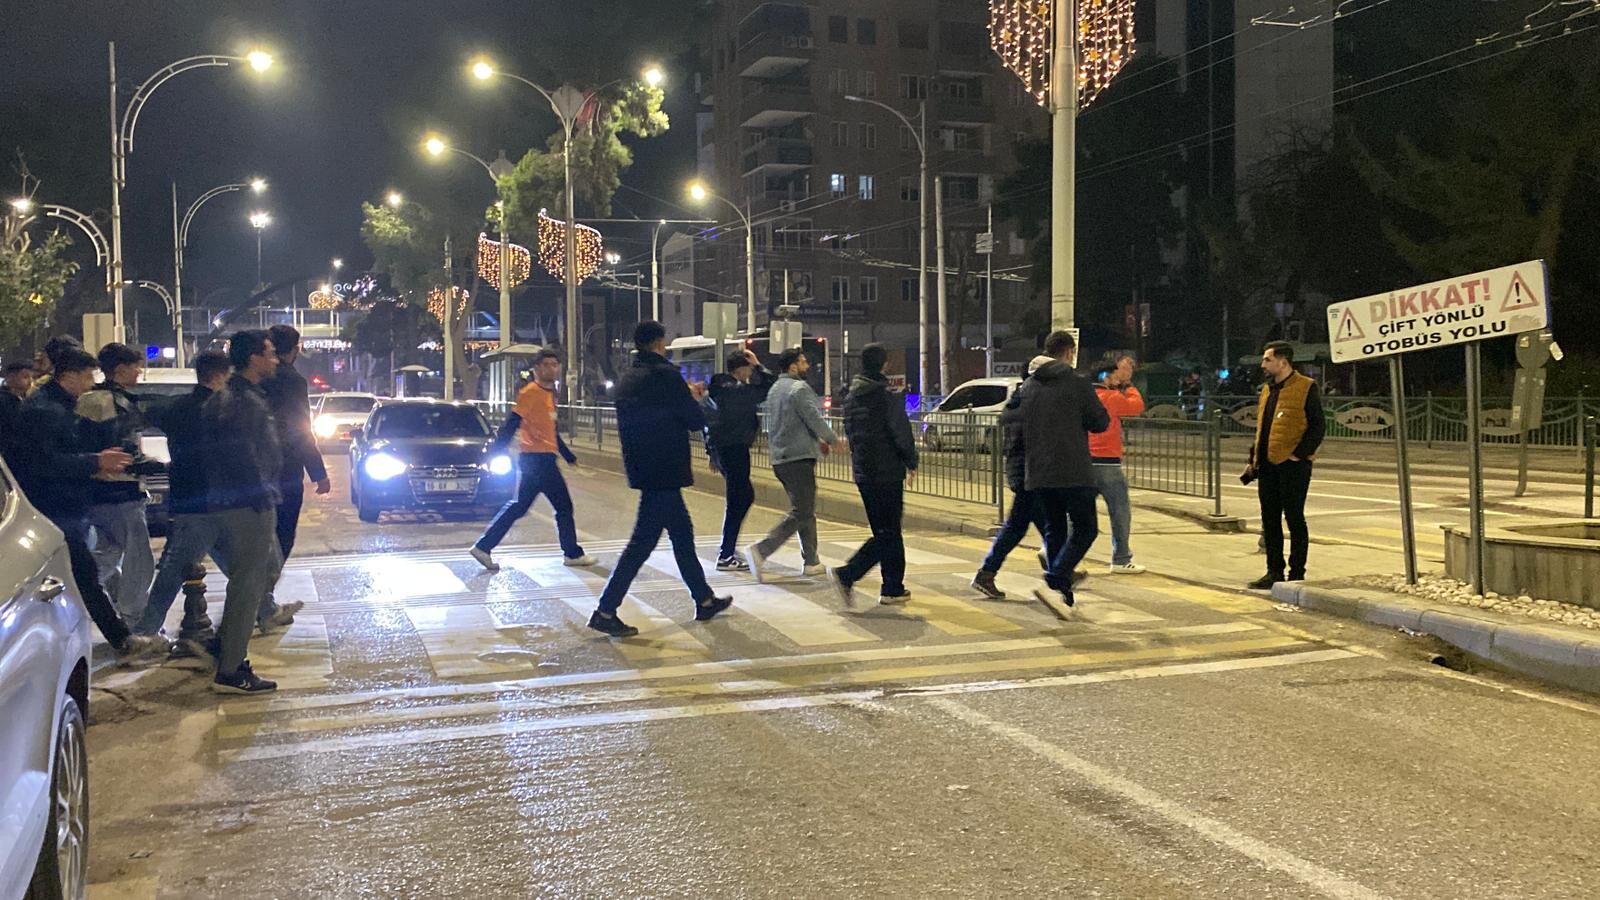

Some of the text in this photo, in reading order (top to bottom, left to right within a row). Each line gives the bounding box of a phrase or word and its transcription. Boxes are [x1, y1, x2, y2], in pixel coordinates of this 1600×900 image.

[1369, 278, 1491, 323] DİKKAT!
[1362, 320, 1507, 355] OTOBÜS YOLU
[1378, 304, 1486, 336] ÇİFT YÖNLÜ
